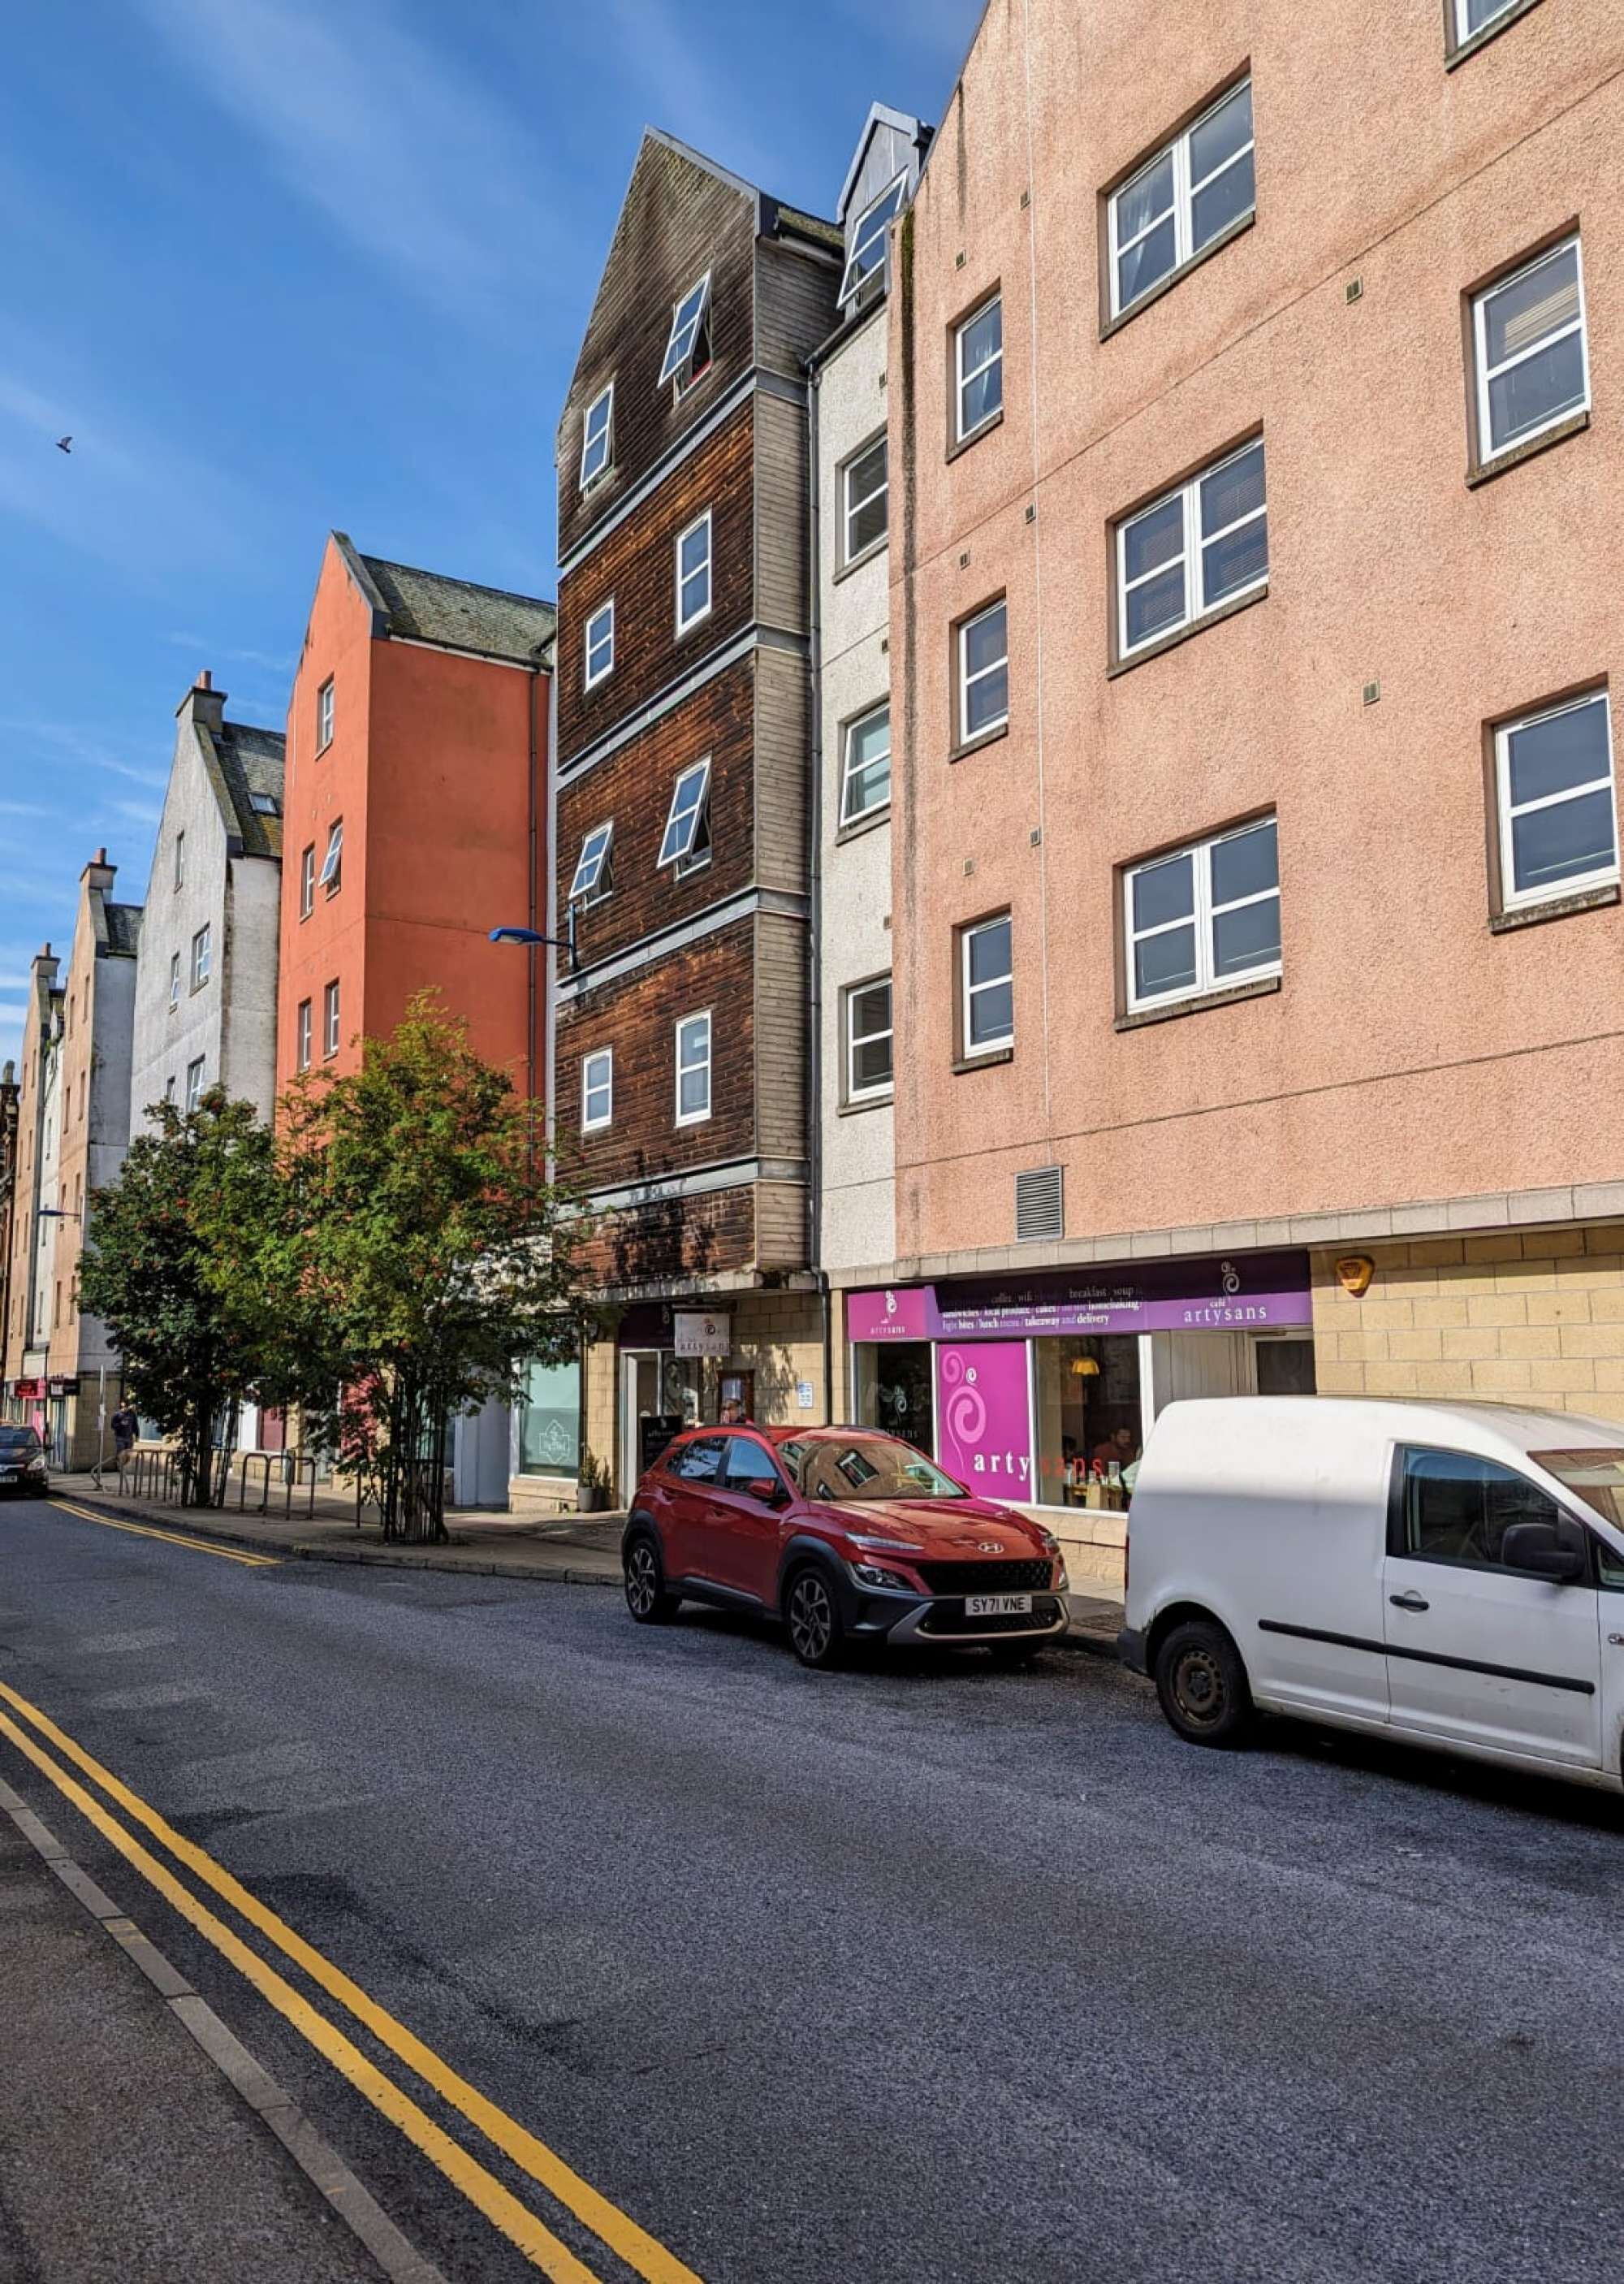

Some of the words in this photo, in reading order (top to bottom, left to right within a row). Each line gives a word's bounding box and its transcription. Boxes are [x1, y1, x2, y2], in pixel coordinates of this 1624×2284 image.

[1069, 1286, 1107, 1299] breakfast
[1112, 1286, 1134, 1298] soup
[1025, 1315, 1060, 1330] takeaway
[1077, 1313, 1109, 1326] delivery
[1184, 1306, 1267, 1326] artysans
[972, 1597, 1000, 1612] SY71
[1002, 1597, 1026, 1611] VNE
